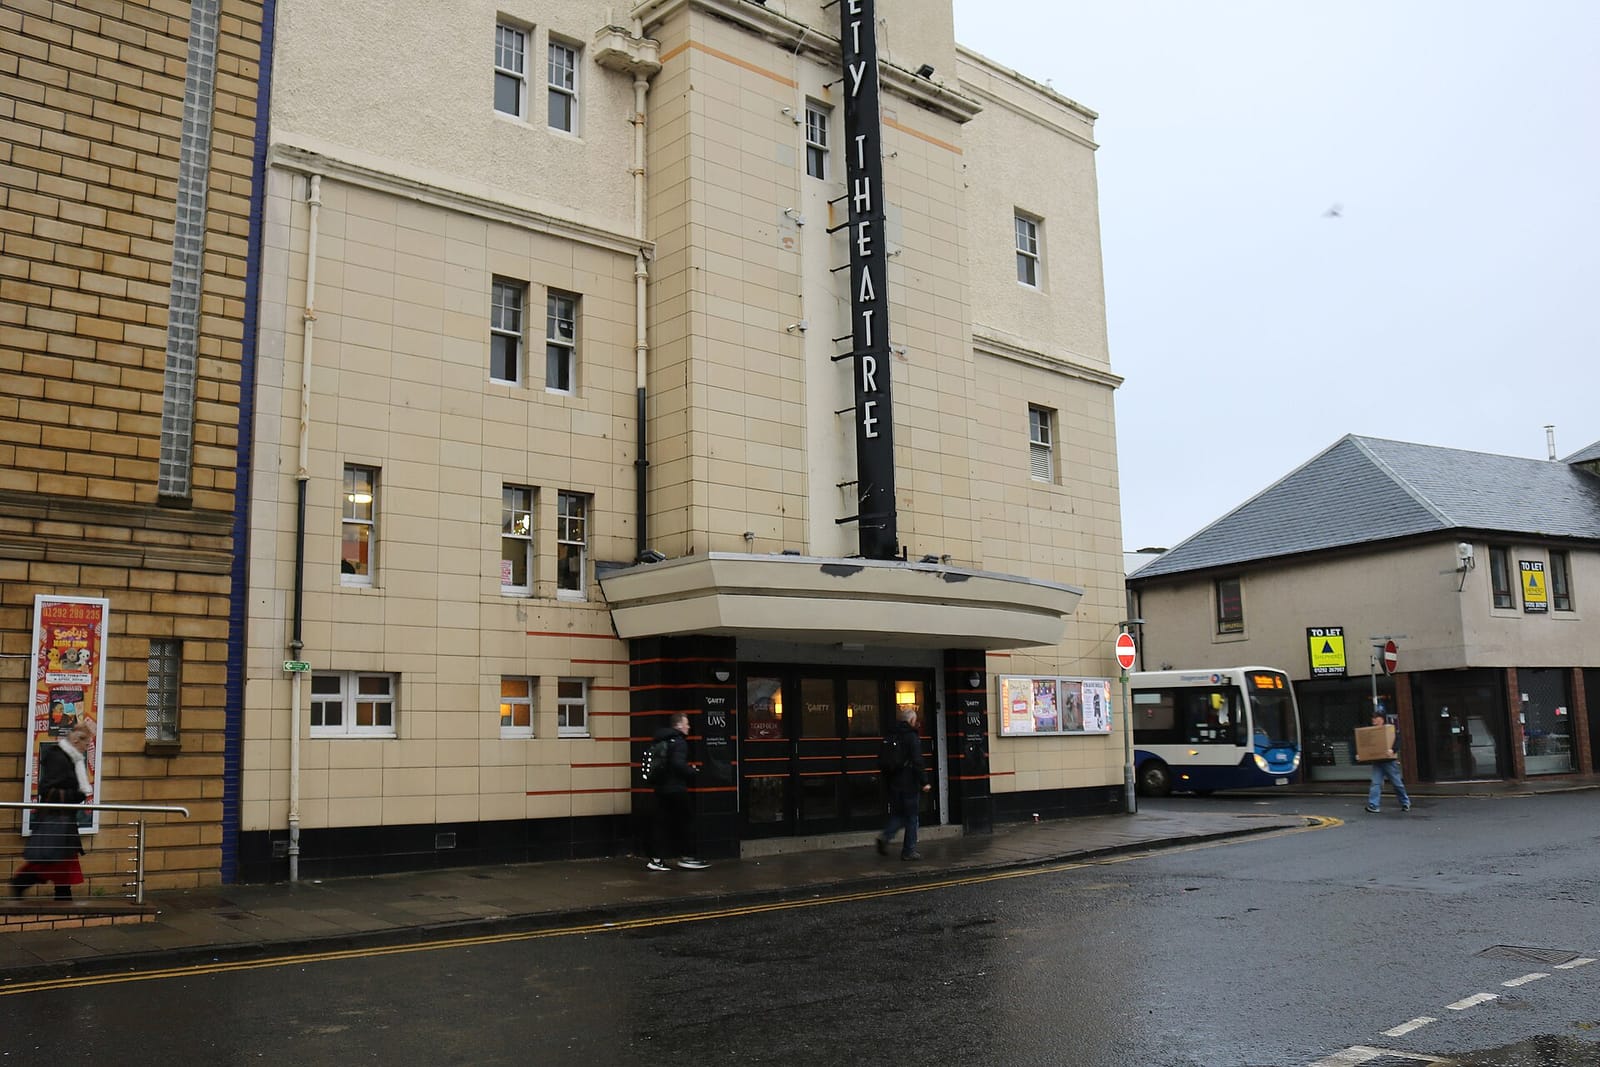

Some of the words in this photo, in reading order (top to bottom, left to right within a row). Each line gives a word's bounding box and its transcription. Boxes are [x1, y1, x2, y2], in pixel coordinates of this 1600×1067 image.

[854, 134, 878, 439] THEATRE
[1521, 562, 1530, 570] TO
[1531, 563, 1542, 571] LET
